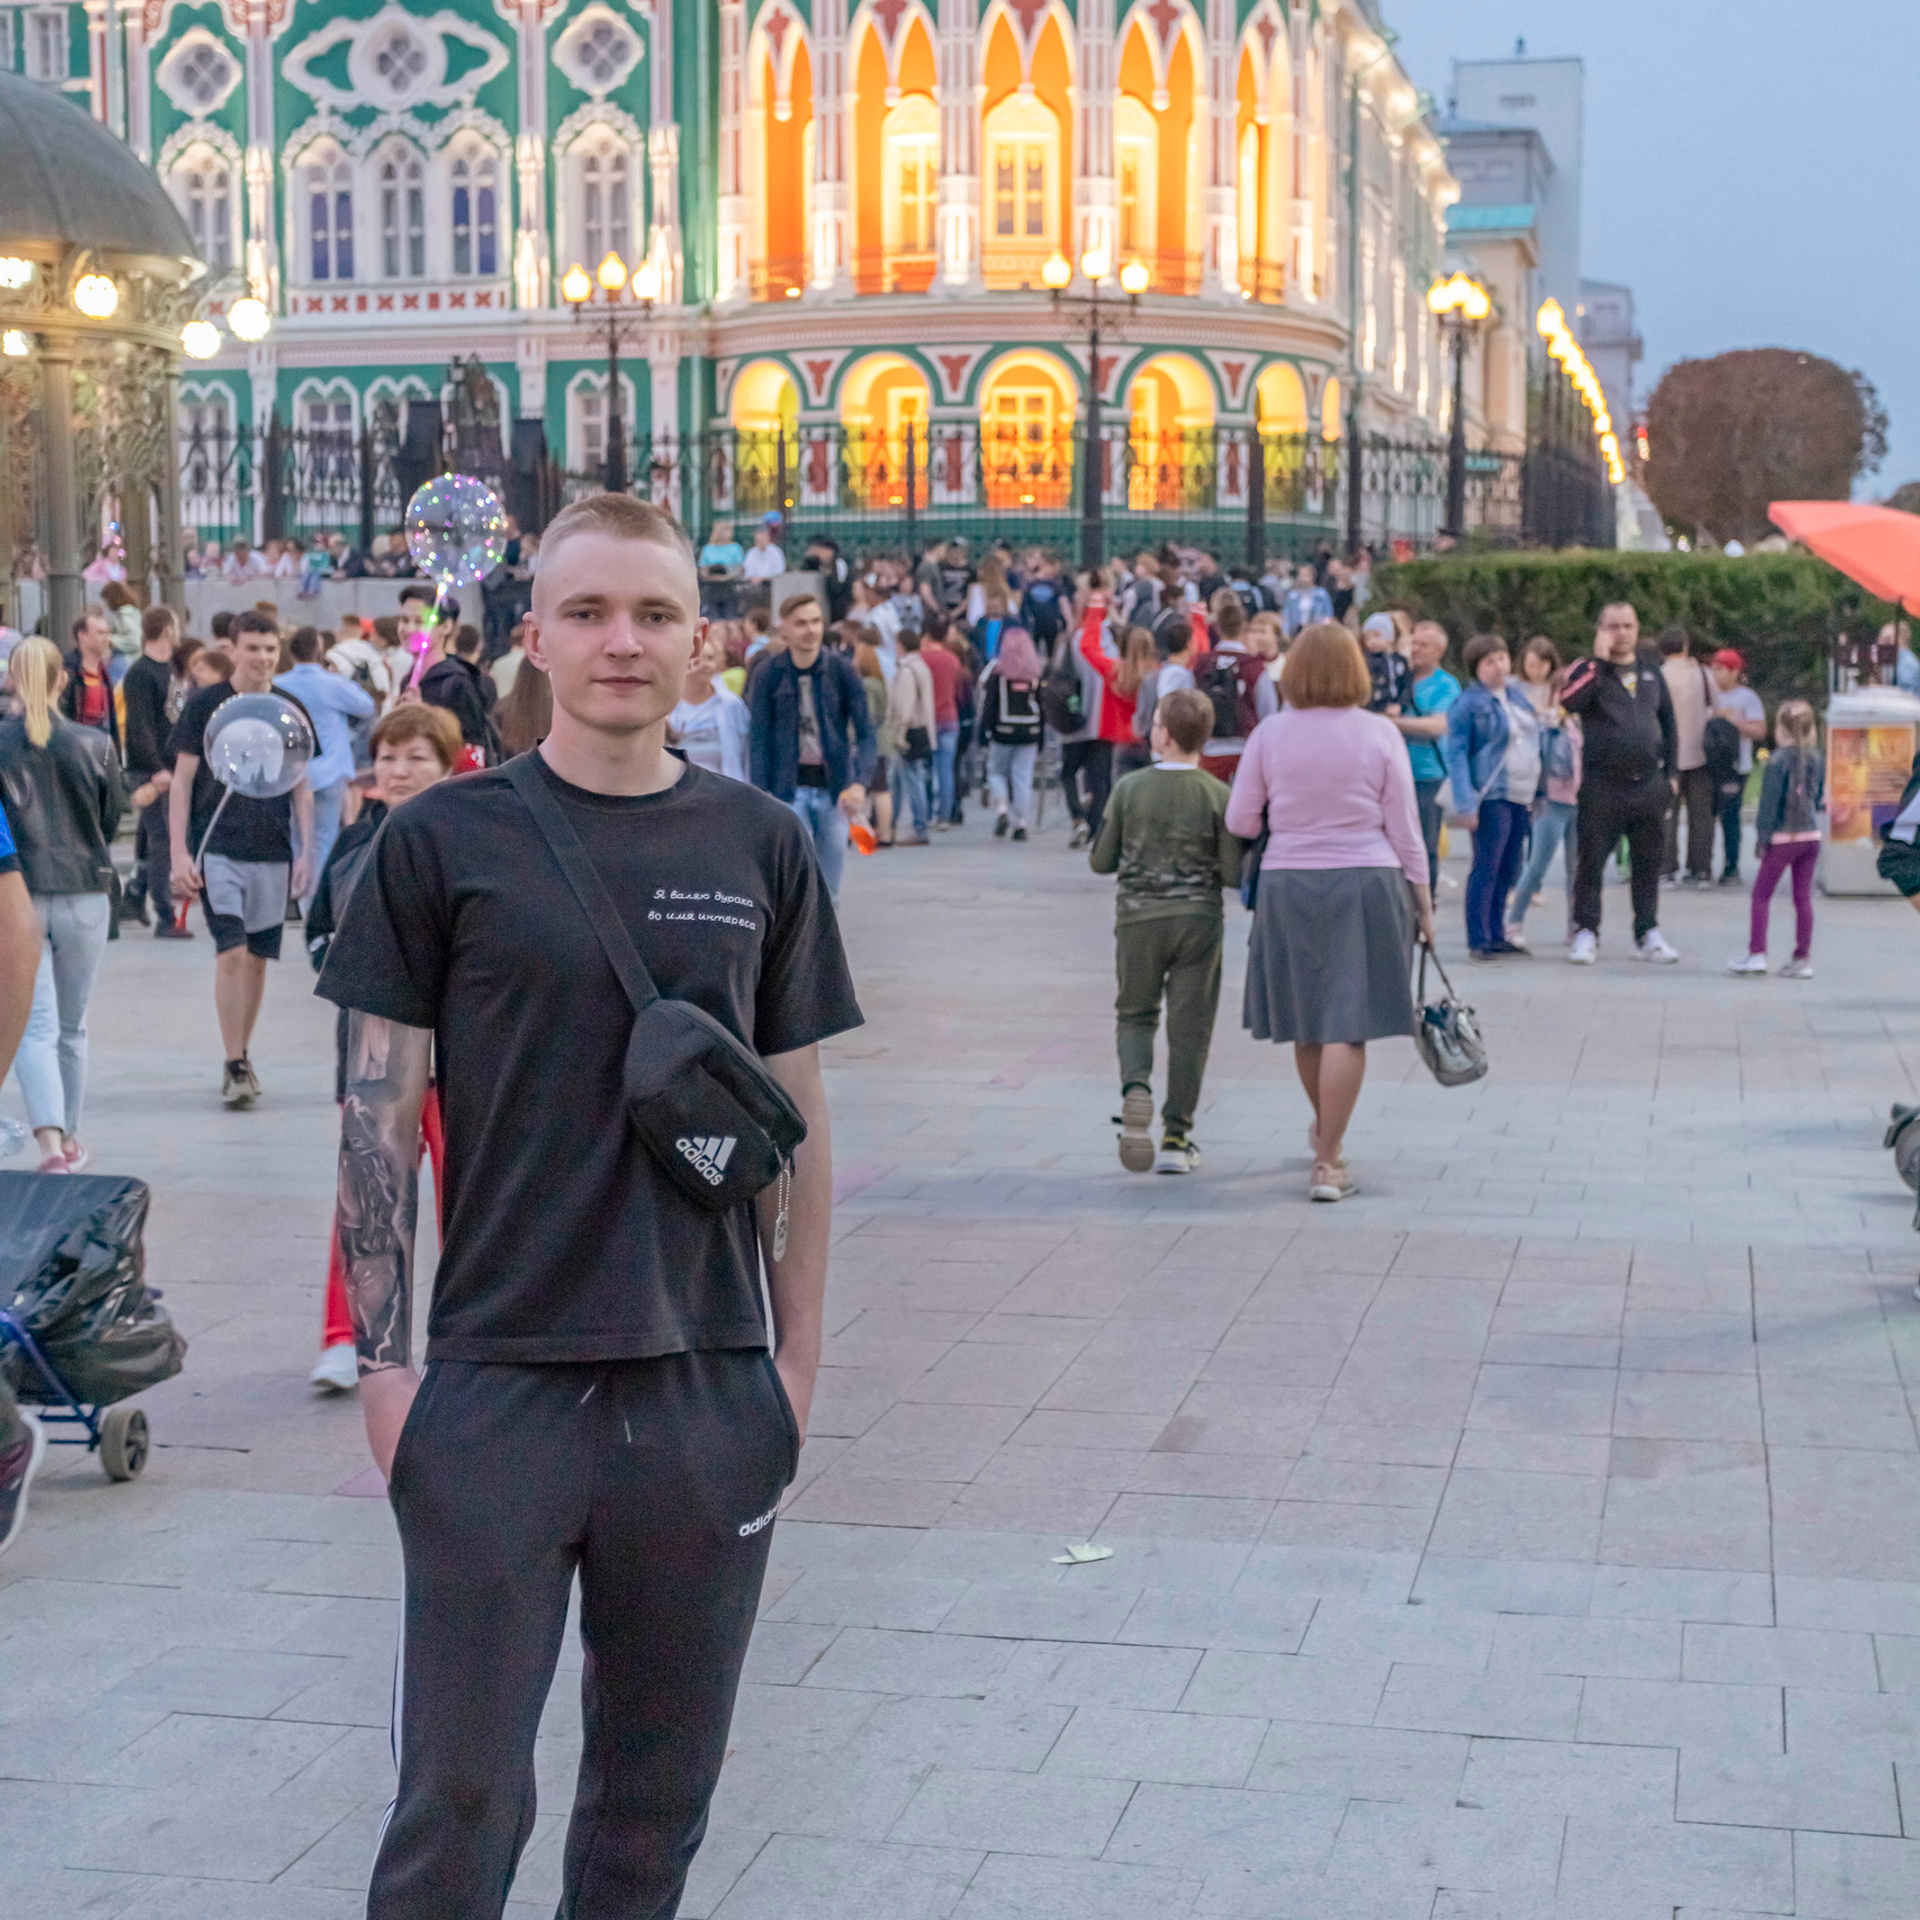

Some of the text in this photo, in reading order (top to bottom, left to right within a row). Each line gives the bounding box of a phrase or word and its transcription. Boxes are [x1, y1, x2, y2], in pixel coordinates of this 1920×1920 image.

[653, 889, 754, 907] Я валяю дурака
[648, 911, 756, 930] во имя интереса
[675, 1139, 724, 1186] adidas
[739, 1500, 779, 1537] adida
